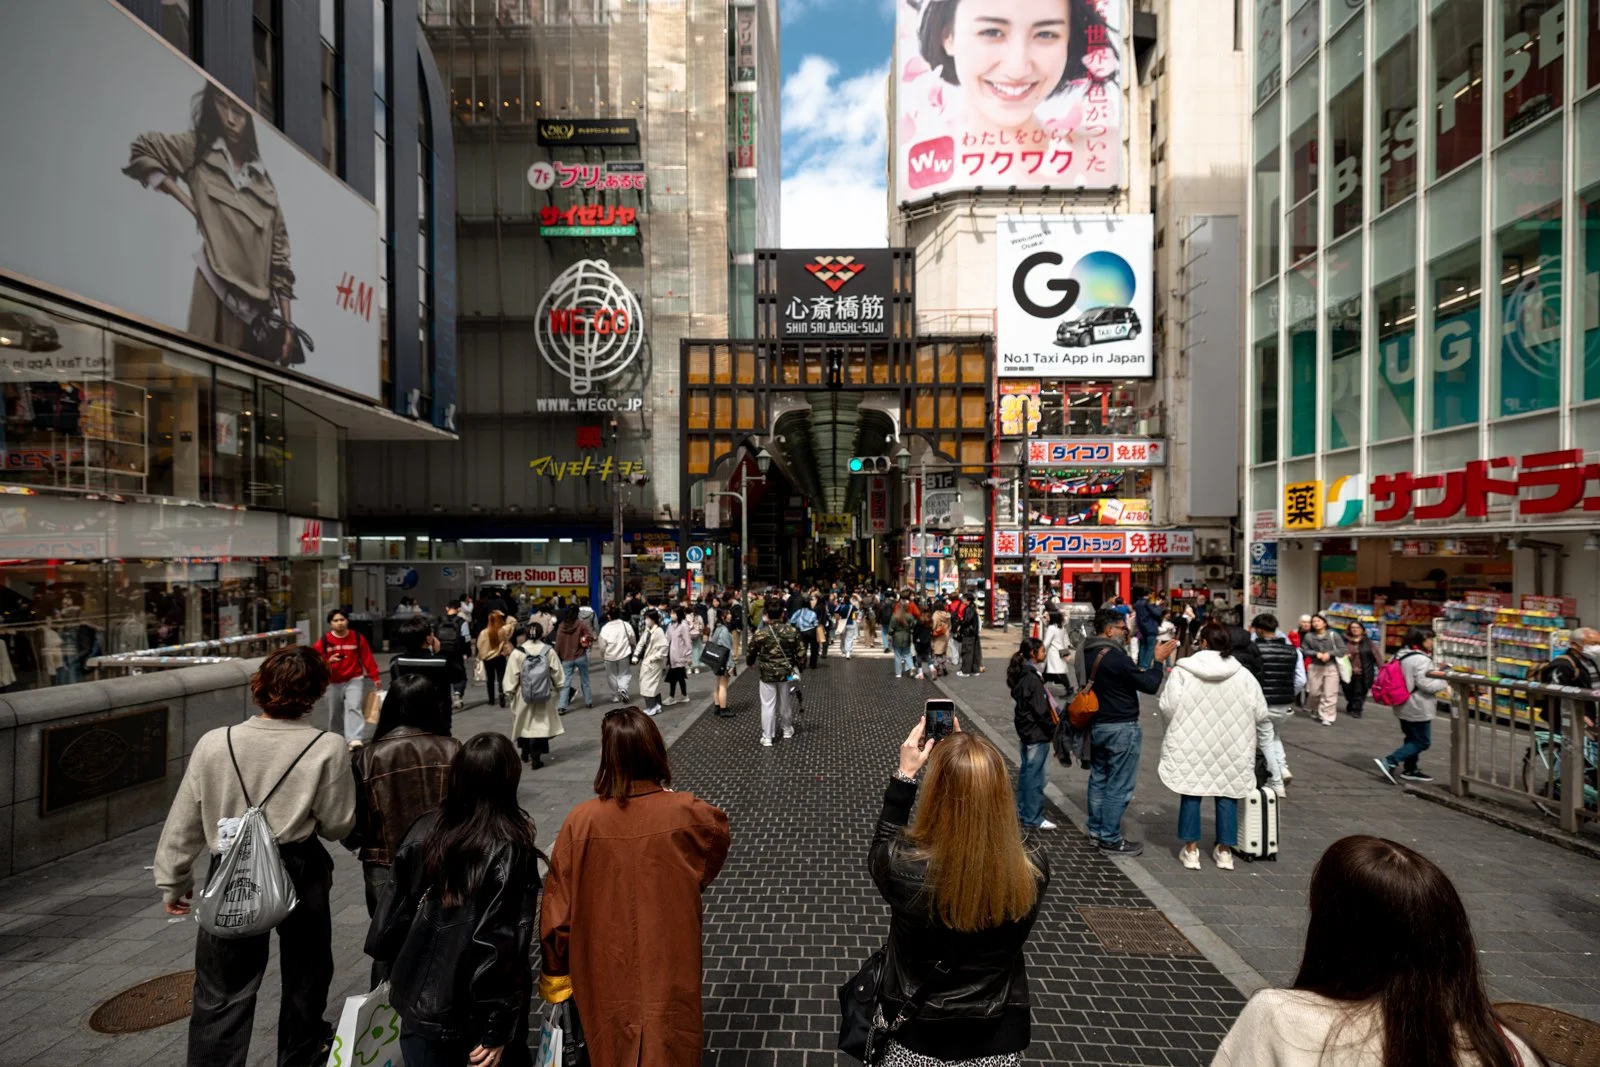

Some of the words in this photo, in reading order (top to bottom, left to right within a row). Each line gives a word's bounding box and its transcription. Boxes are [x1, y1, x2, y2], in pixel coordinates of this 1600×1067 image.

[962, 129, 1075, 147] わたしをひらく
[962, 150, 1073, 176] ワクワク
[534, 169, 550, 184] 7F
[540, 204, 635, 226] サイゼリヤ
[336, 271, 374, 324] H&M
[785, 295, 884, 320] 心斎橋筋
[786, 322, 808, 334] SHIN
[1004, 353, 1029, 363] No.1
[1033, 353, 1059, 363] Taxi
[1062, 353, 1089, 365] App
[1092, 352, 1104, 363] in
[1107, 353, 1145, 365] Japan
[536, 398, 642, 412] WWW.WEGO.JP
[1052, 445, 1111, 460] ダイコク
[1117, 444, 1147, 461] 免税
[529, 455, 647, 481] マツモトキヨシ
[1287, 486, 1316, 524] 薬
[1022, 534, 1122, 552] ダイコクドラッグ
[1129, 533, 1168, 554] 免税
[1173, 534, 1189, 543] Tax
[1171, 544, 1191, 553] Free
[495, 569, 522, 581] Free
[524, 568, 557, 585] Shop
[561, 569, 586, 583] 免税
